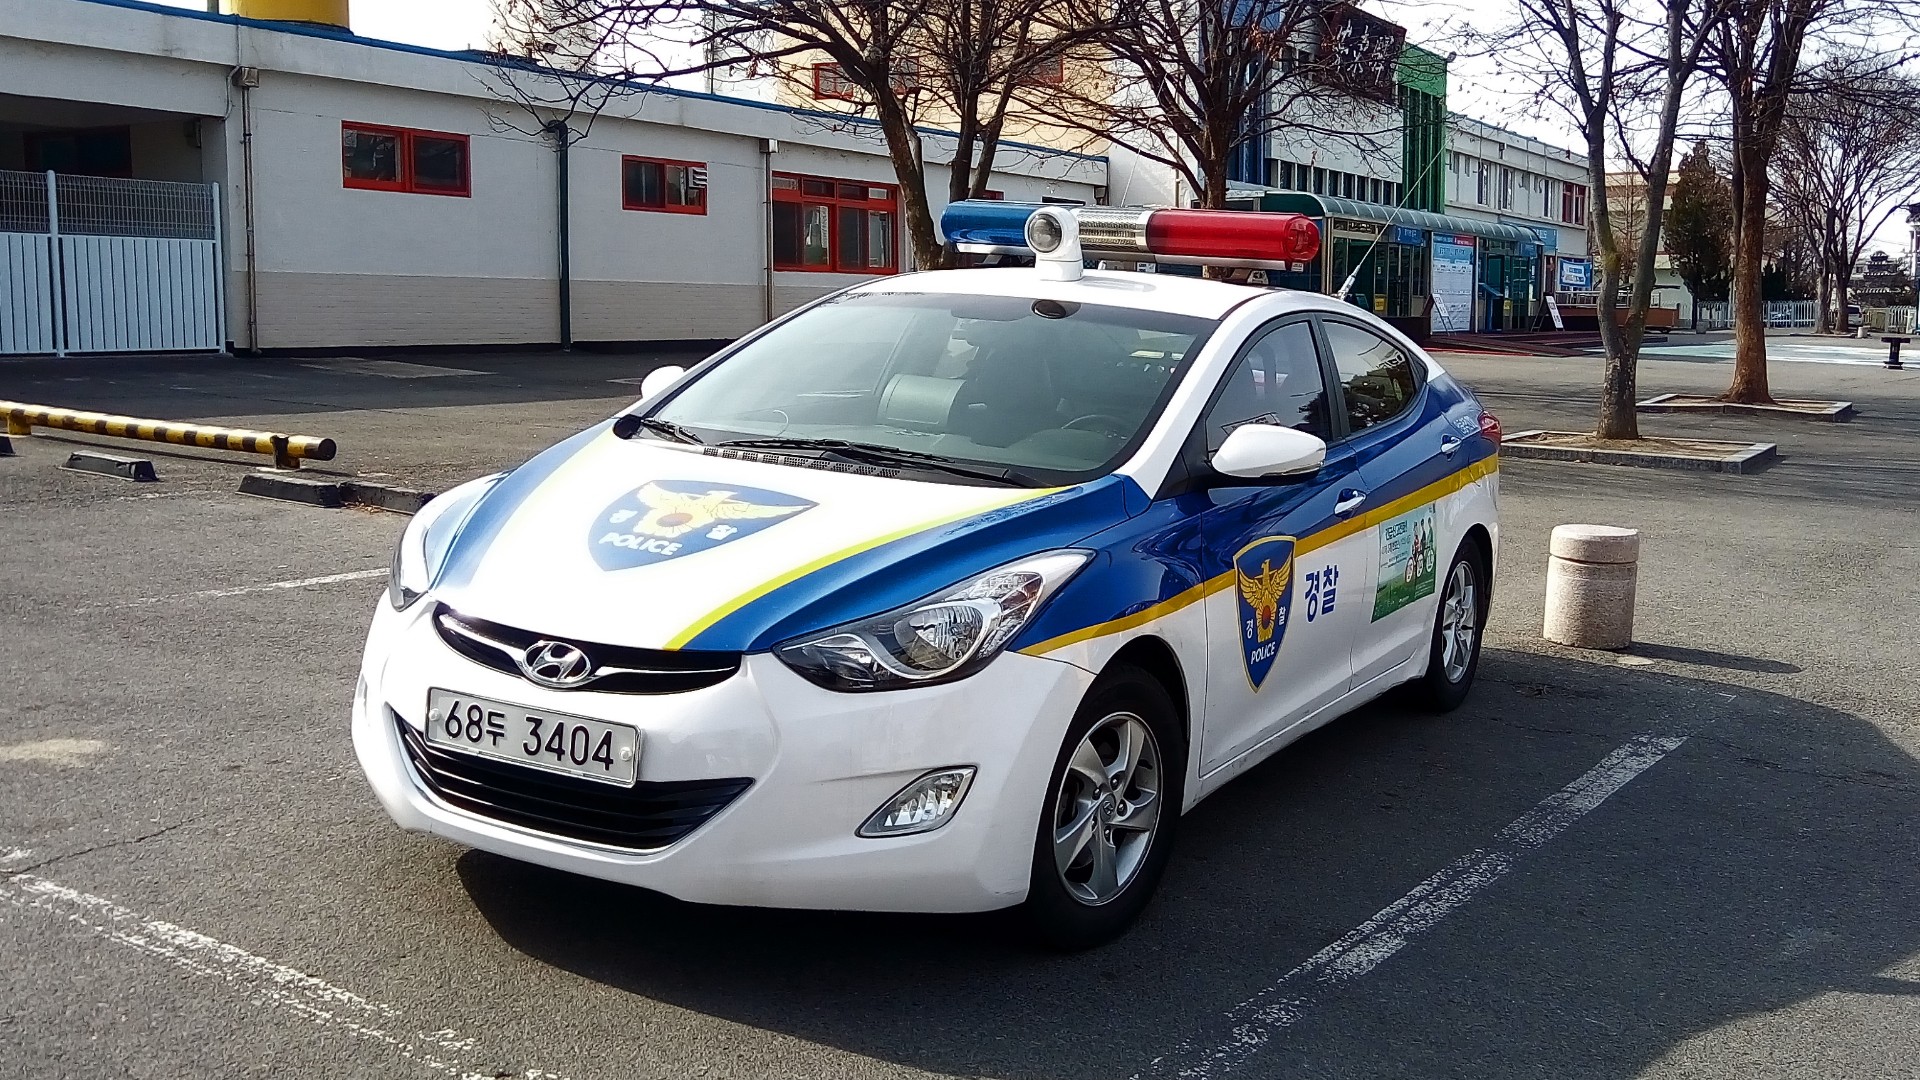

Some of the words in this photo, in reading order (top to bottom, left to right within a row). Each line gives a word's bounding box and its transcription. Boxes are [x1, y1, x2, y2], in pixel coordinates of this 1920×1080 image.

[598, 531, 683, 556] POLICE
[1304, 564, 1339, 624] 경찰
[1245, 619, 1254, 639] 경
[1278, 606, 1287, 626] 찰
[1250, 641, 1276, 665] POLICE
[444, 700, 506, 747] 68두
[522, 716, 614, 771] 3404
